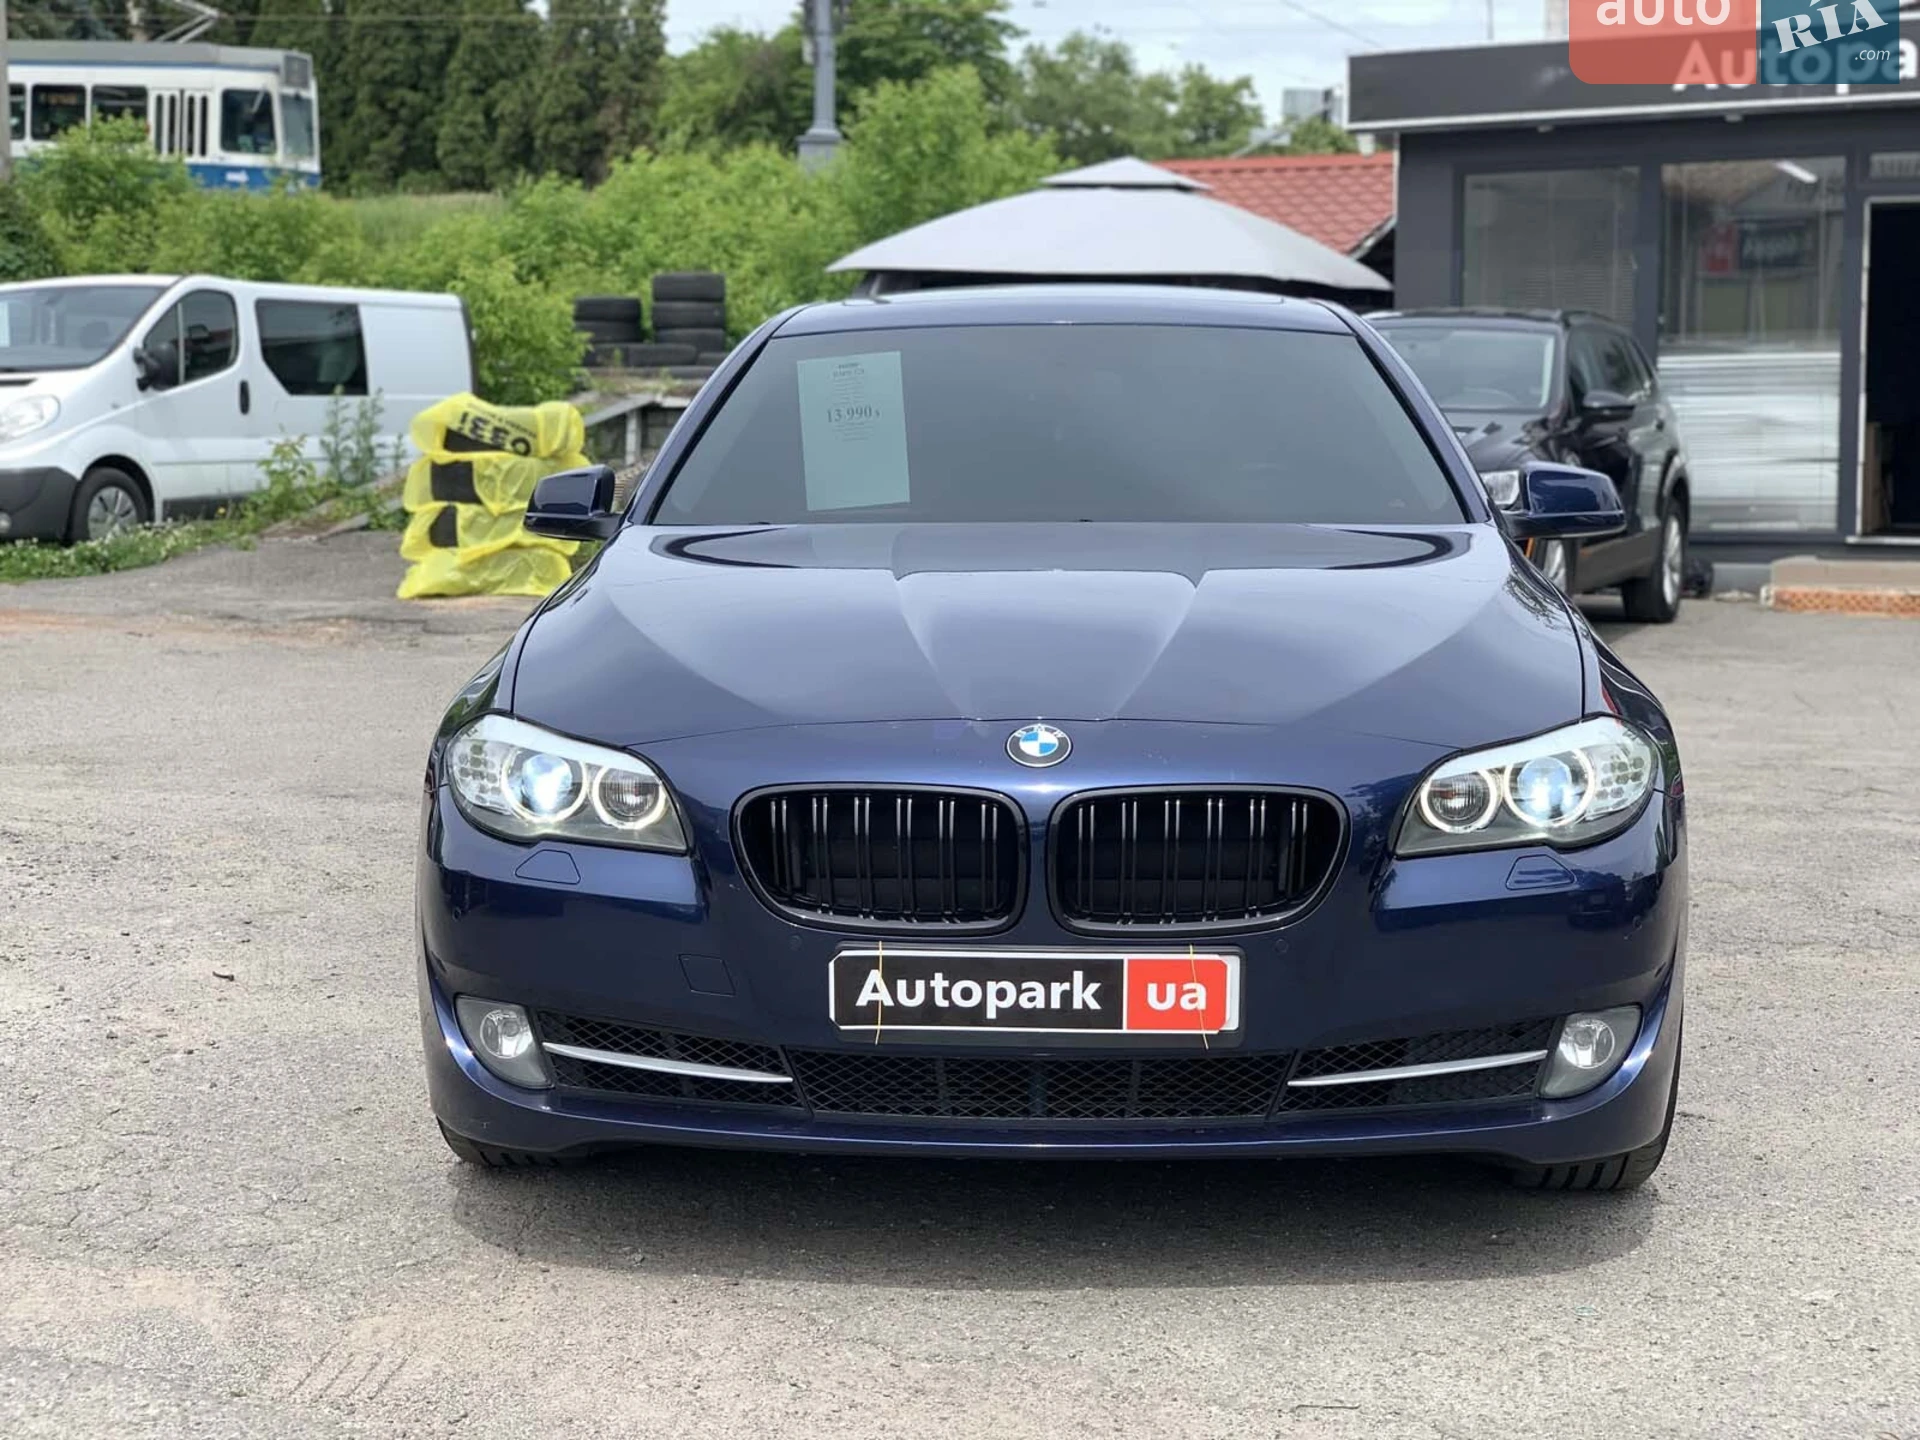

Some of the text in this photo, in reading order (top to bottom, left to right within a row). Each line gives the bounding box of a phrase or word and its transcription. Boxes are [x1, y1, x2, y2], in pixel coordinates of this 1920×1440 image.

[1014, 724, 1064, 739] BMW
[855, 968, 1207, 1019] Autopark ua
